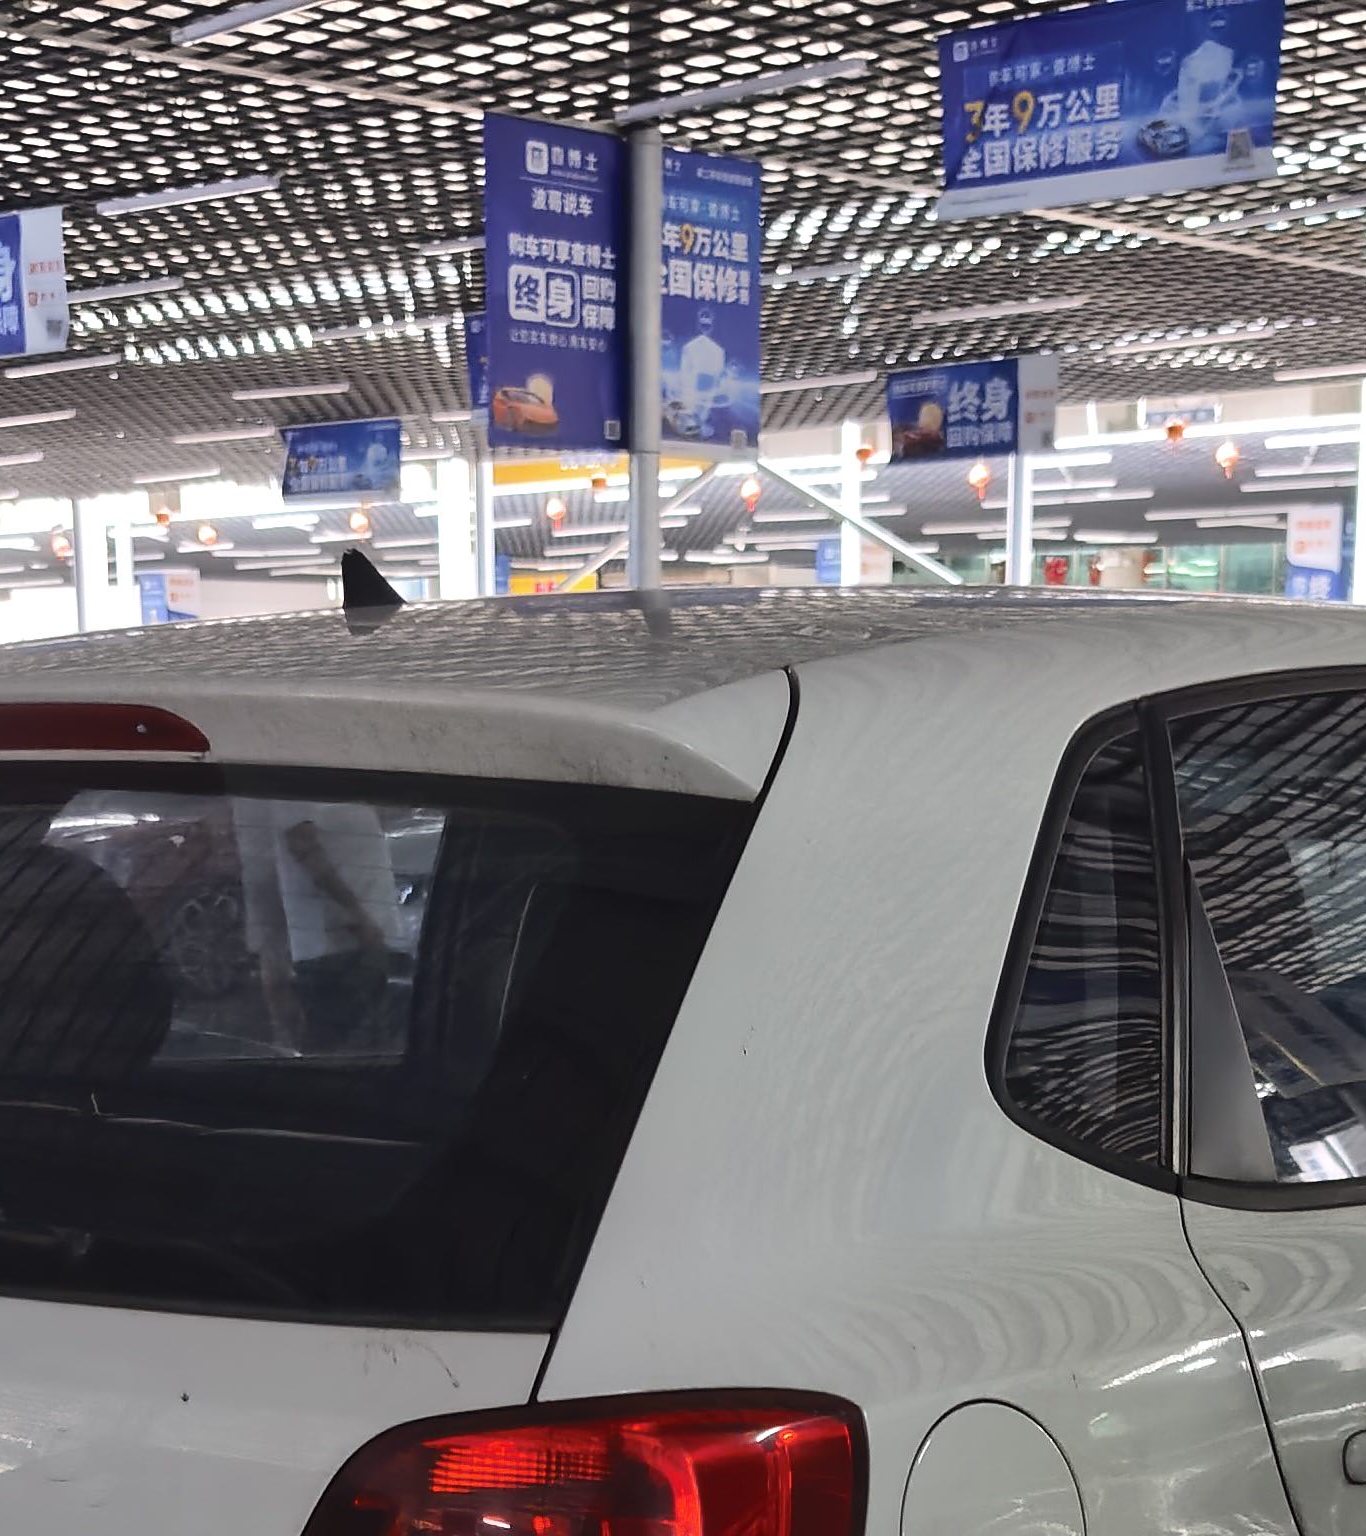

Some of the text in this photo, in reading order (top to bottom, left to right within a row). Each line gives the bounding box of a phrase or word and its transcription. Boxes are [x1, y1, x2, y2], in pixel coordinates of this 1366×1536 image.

[955, 128, 1124, 181] 全国保修服务
[507, 232, 617, 271] 购车可享查博士
[511, 272, 617, 322] 终身 回购
[582, 303, 617, 331] 保障
[946, 377, 1013, 423] 终身
